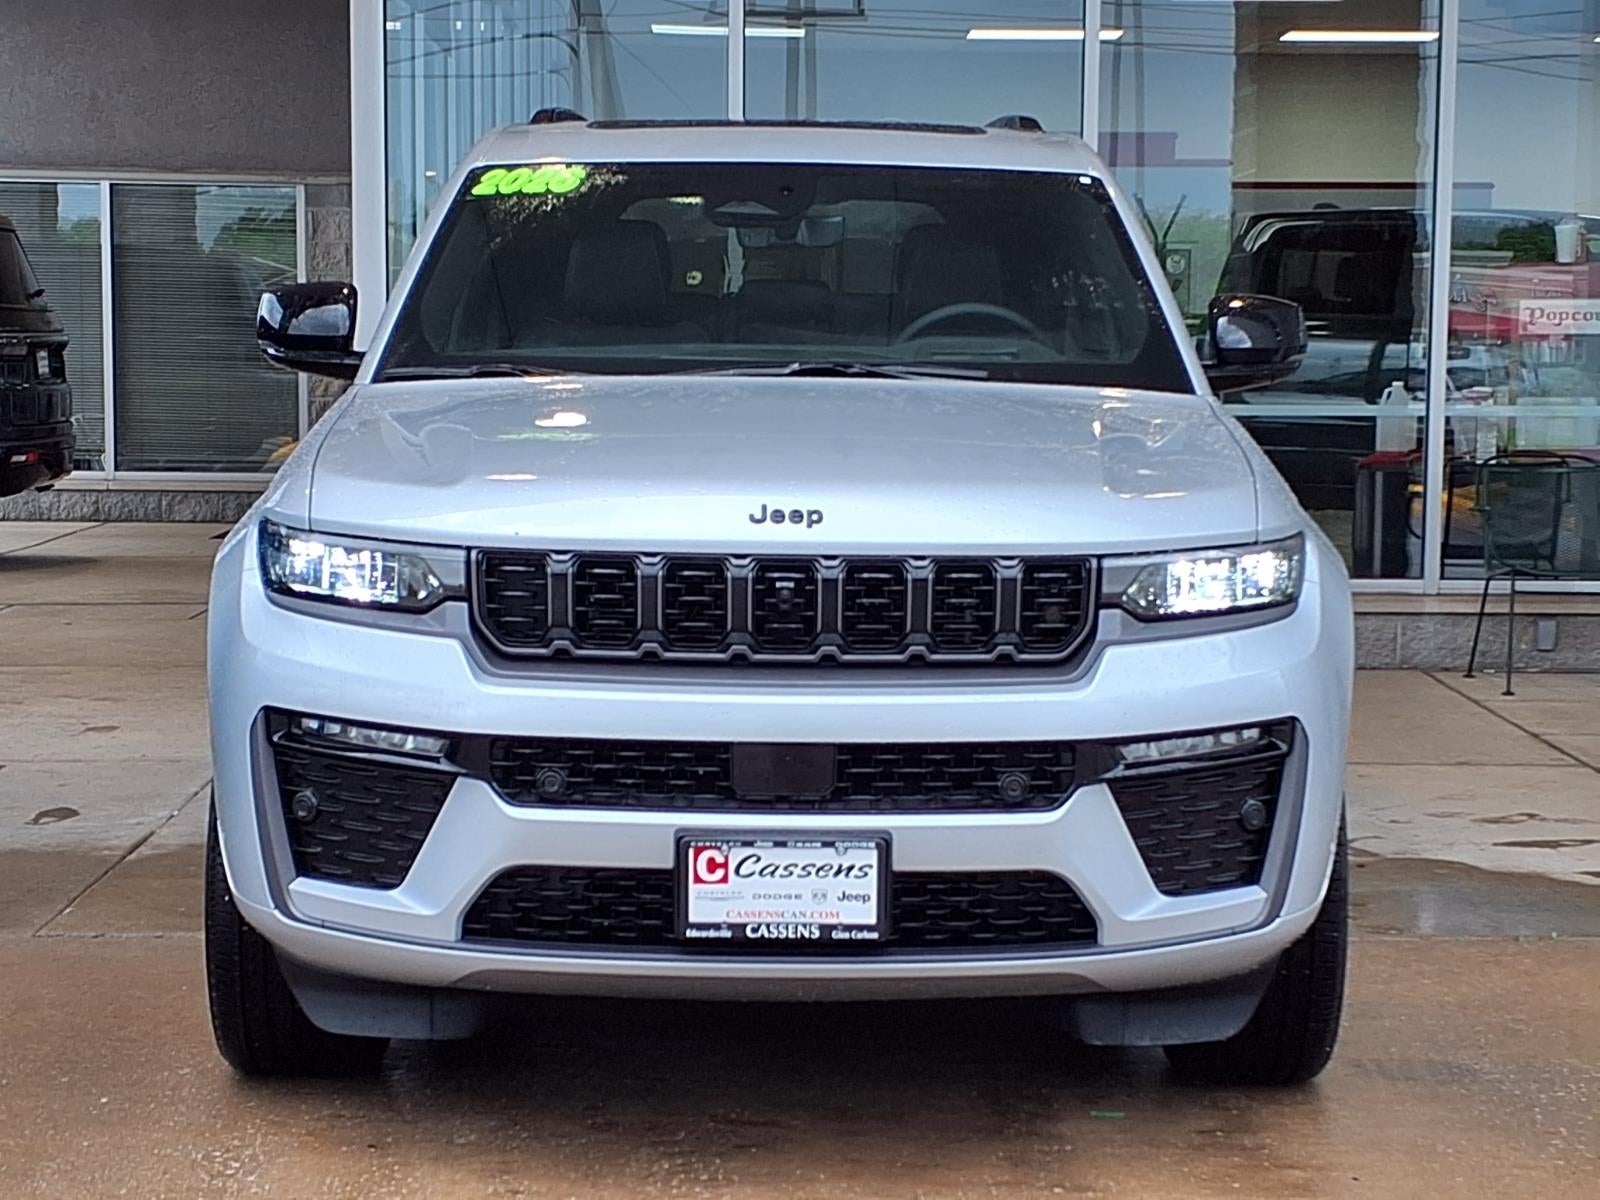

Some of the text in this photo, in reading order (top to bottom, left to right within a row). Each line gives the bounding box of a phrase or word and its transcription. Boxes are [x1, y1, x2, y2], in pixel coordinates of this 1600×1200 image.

[748, 503, 824, 529] Jeep
[734, 853, 874, 880] Cassens
[837, 890, 871, 904] Jeep
[726, 909, 840, 920] CASSENSCAN.COM
[745, 924, 820, 938] CASSENS
